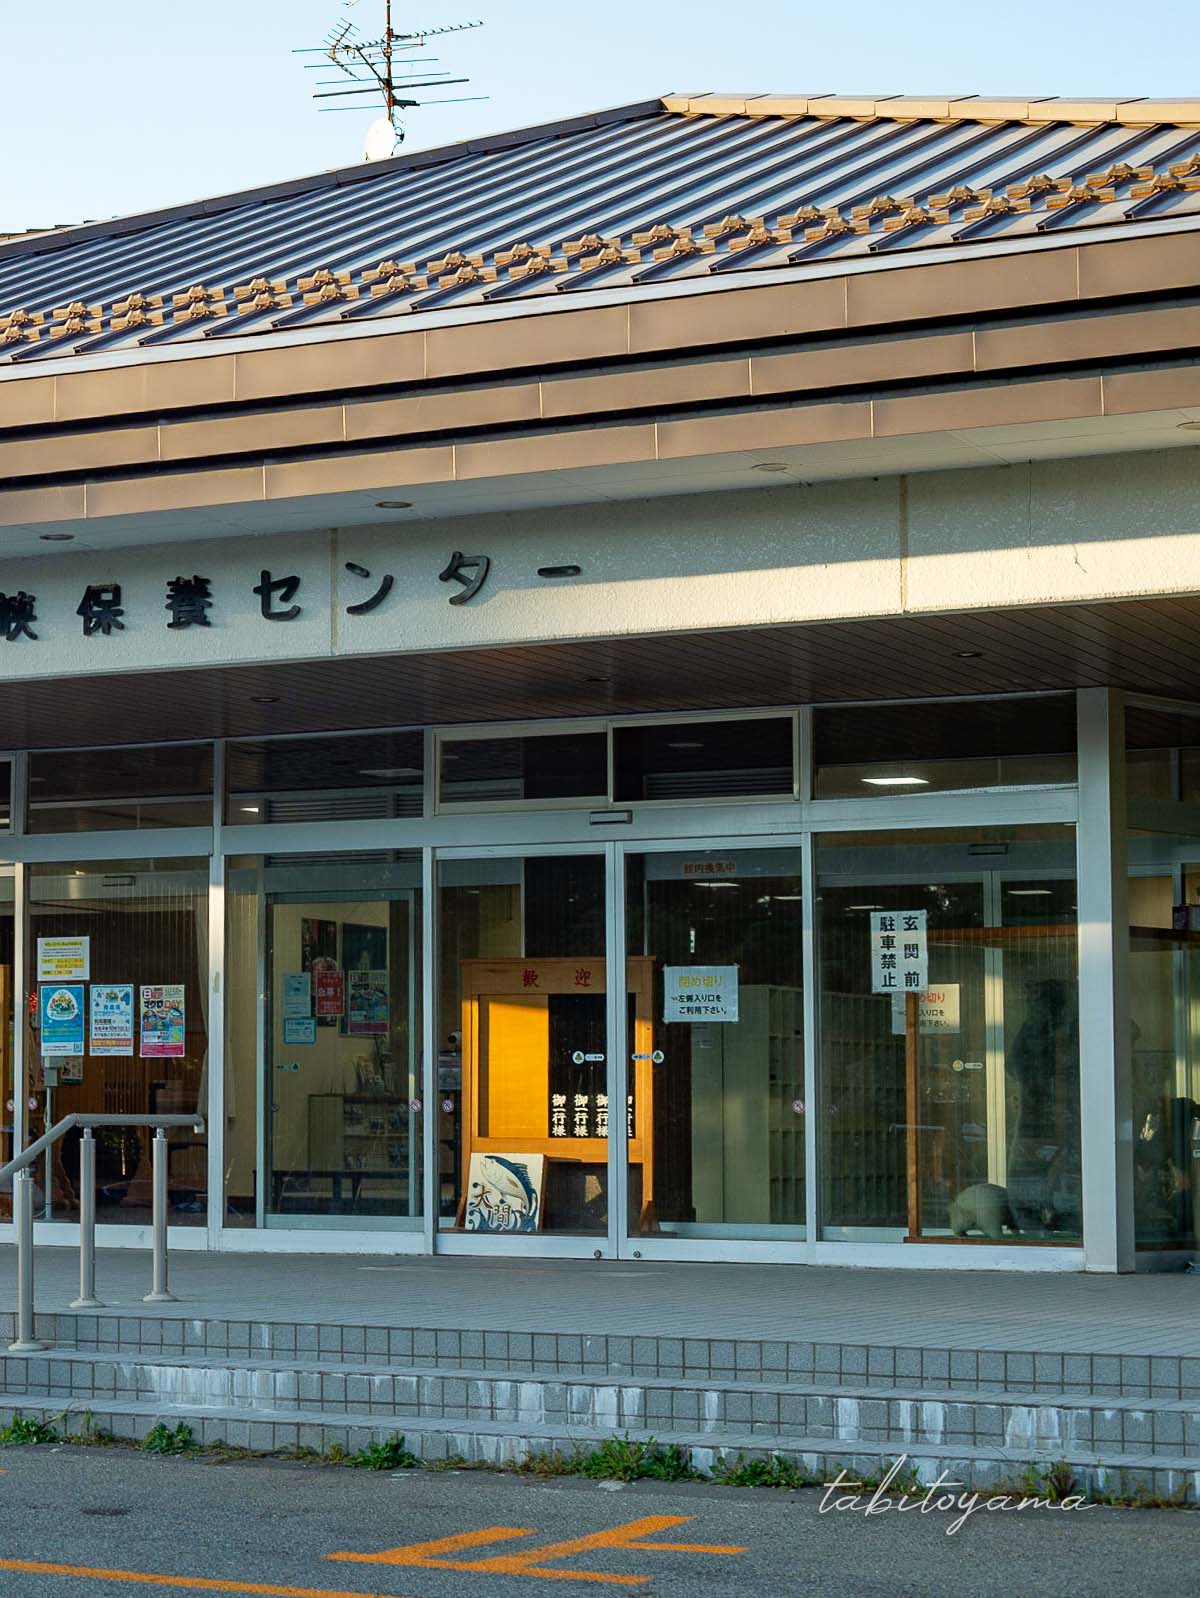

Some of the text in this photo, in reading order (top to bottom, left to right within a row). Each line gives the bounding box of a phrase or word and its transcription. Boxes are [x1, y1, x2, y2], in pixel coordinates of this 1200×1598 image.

[880, 916, 897, 987] 駐車禁止
[903, 915, 920, 987] 玄関前
